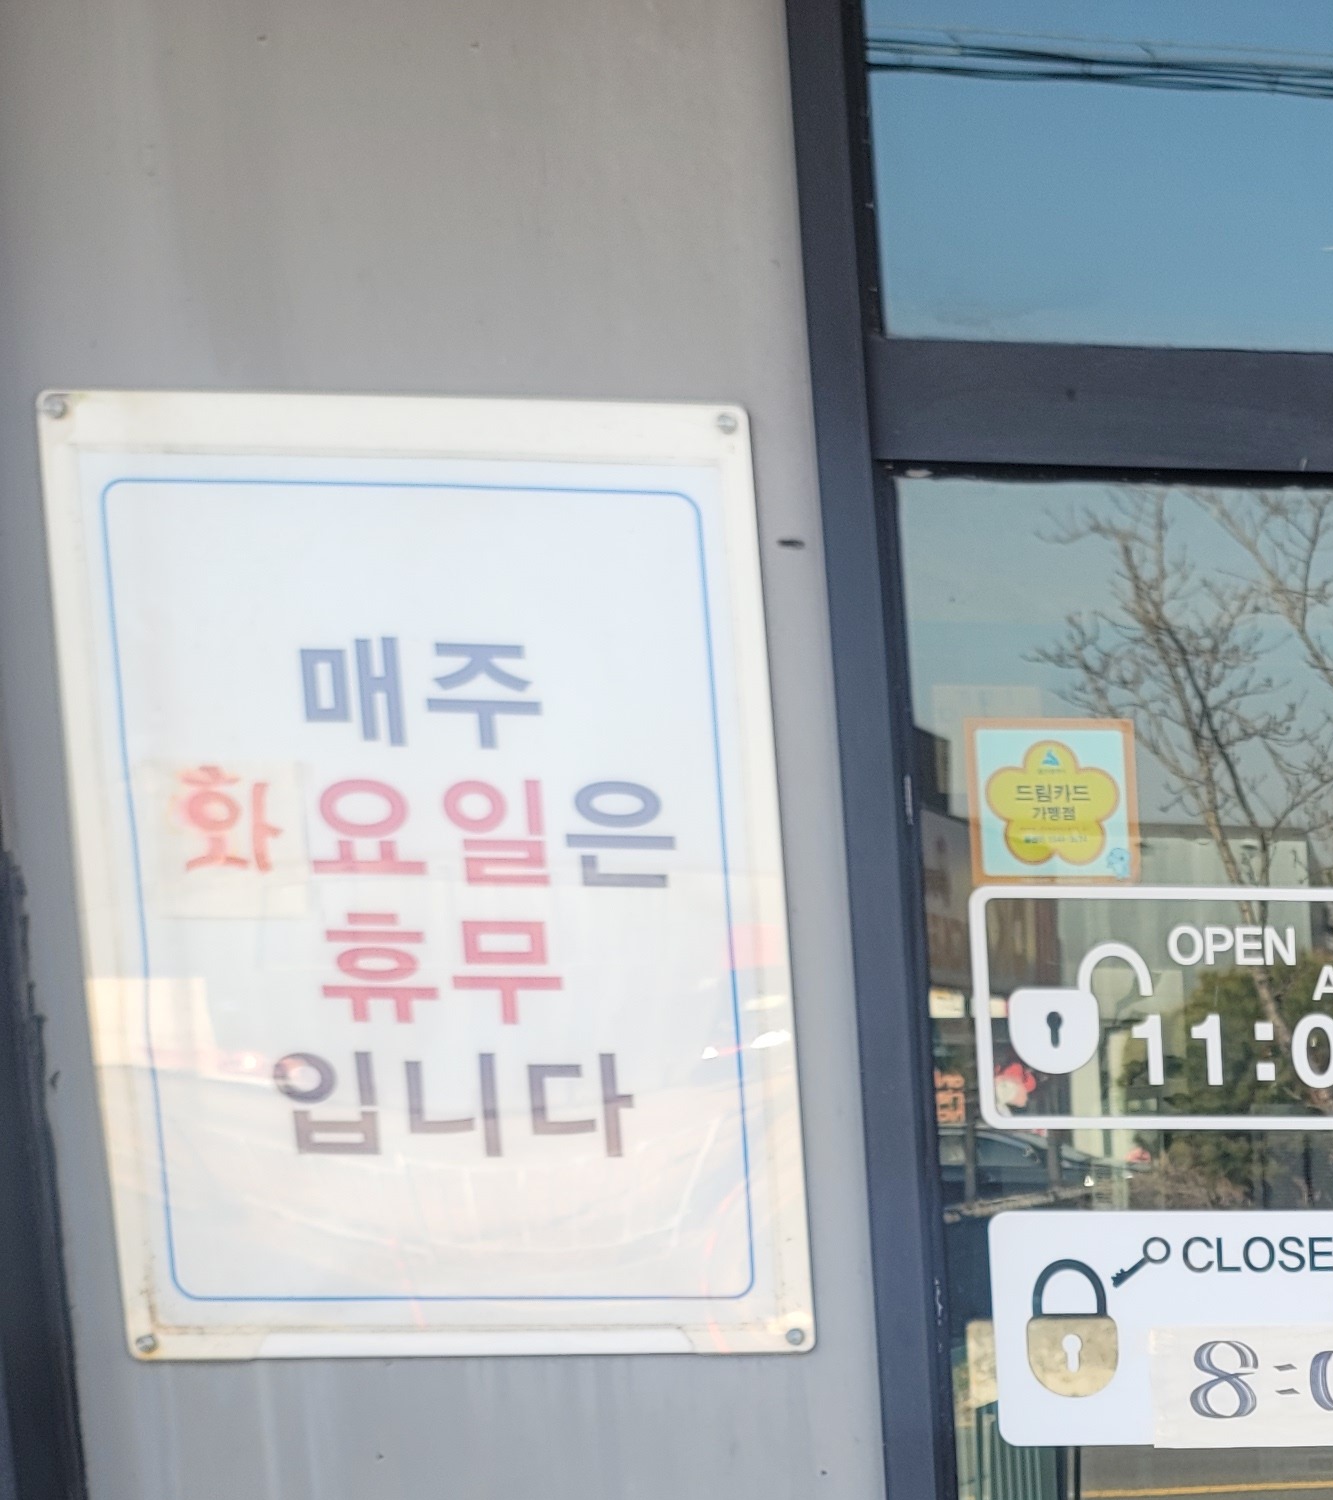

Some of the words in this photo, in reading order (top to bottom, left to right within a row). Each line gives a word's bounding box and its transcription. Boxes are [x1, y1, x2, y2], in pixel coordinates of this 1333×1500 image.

[298, 635, 543, 751] 매주
[172, 763, 677, 889] 화요일은
[1015, 784, 1092, 803] 드림카드
[321, 911, 564, 1026] 휴무
[1167, 924, 1298, 967] OPEN
[272, 1050, 635, 1158] 입니다
